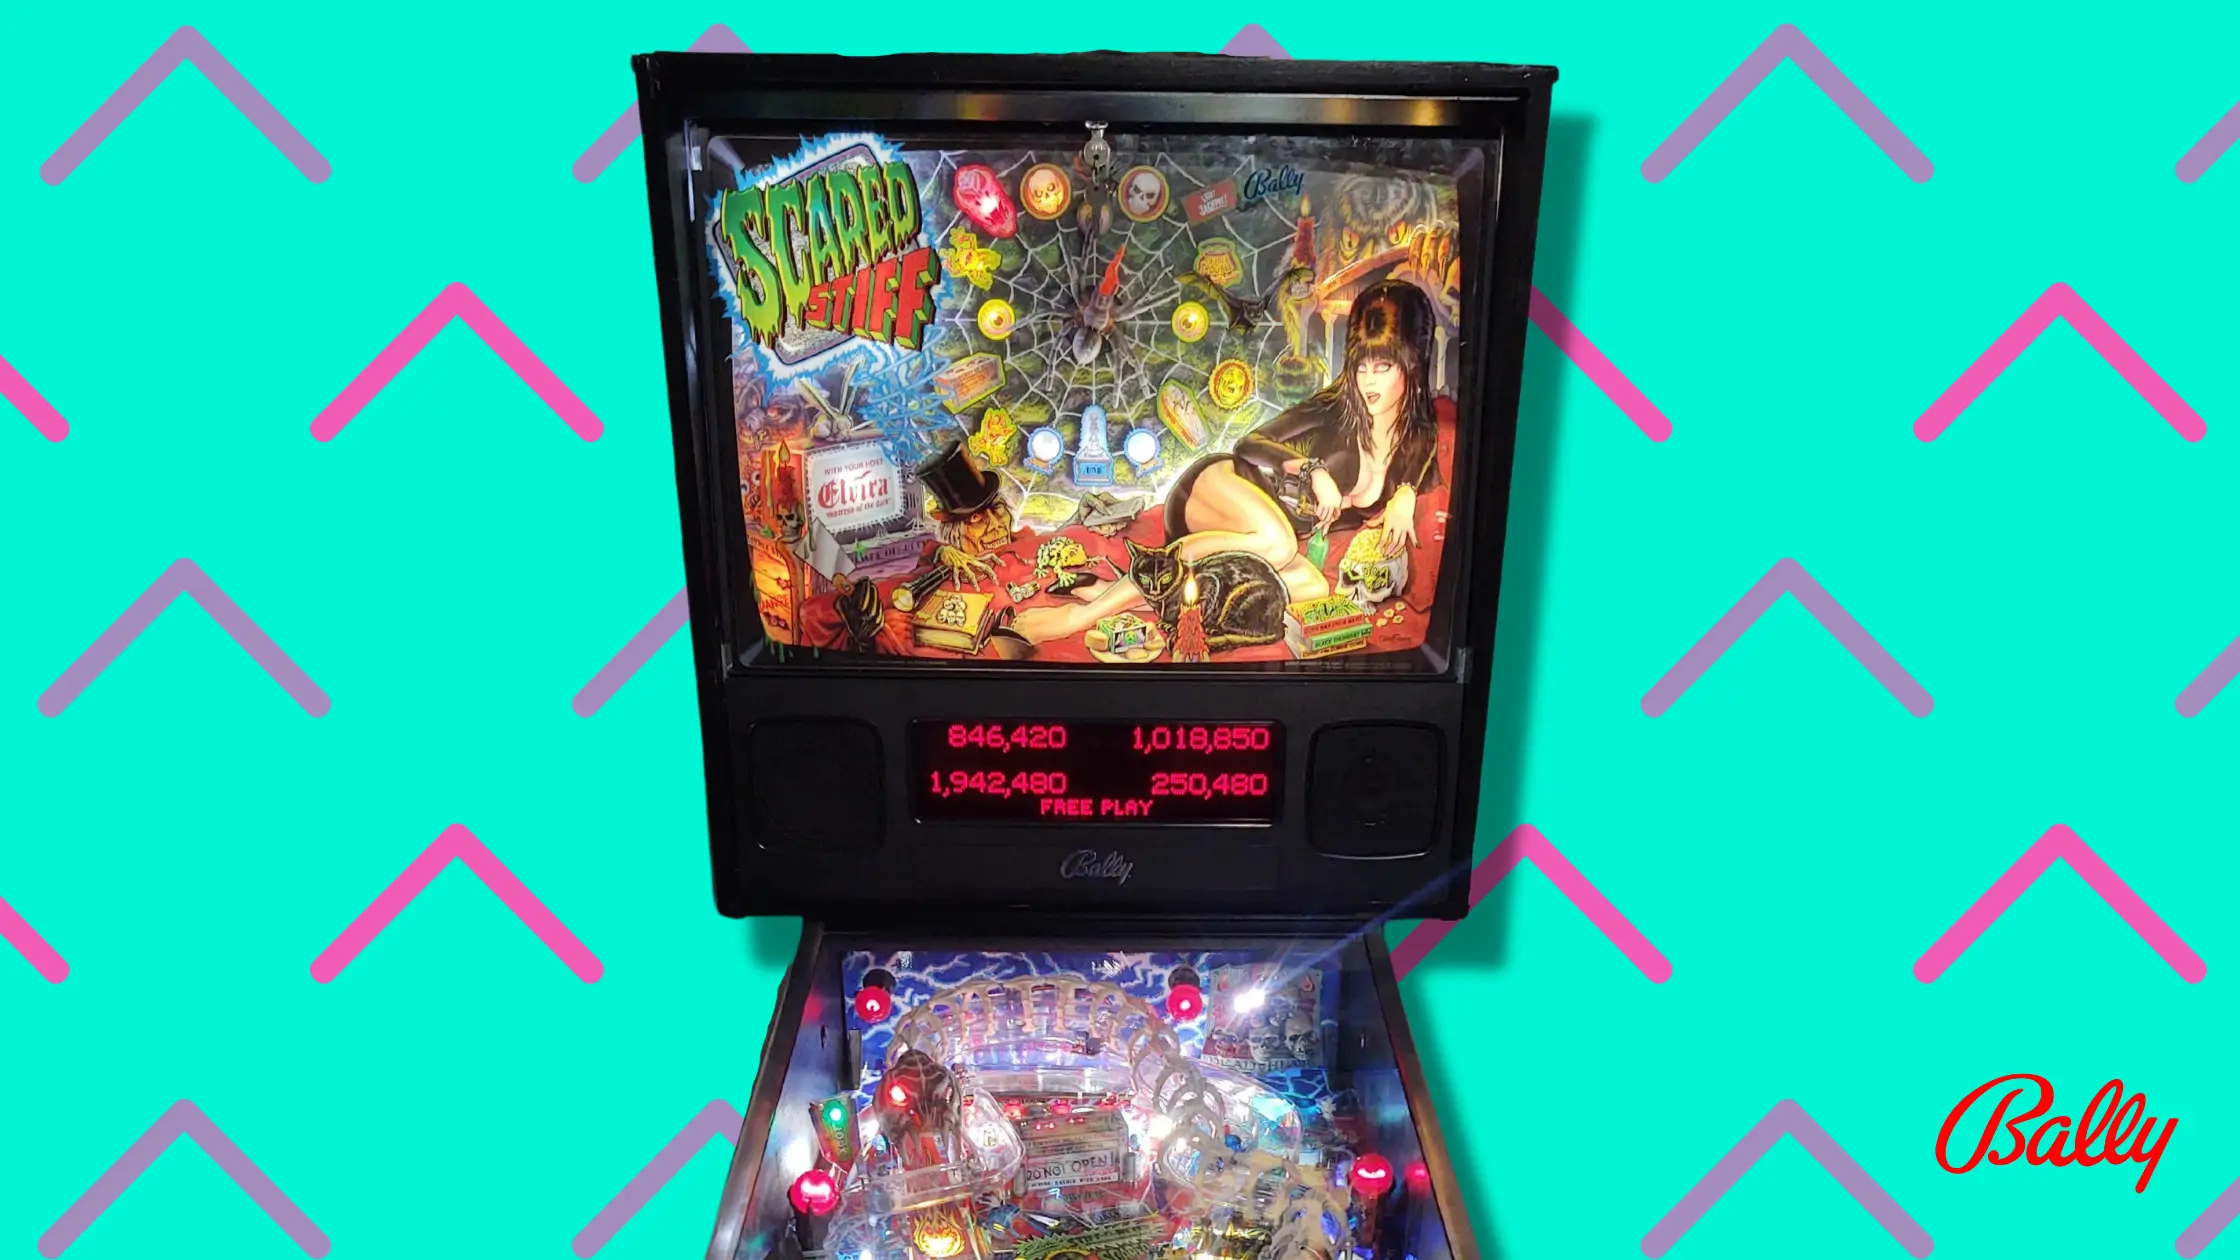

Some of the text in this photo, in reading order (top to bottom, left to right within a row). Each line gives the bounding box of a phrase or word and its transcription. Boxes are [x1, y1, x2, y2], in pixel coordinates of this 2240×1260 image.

[1243, 164, 1305, 200] Bally
[720, 162, 922, 349] SCARED
[805, 246, 941, 351] STIFF
[824, 458, 884, 476] WITH YOUR HOST
[817, 470, 889, 509] Elvira
[864, 500, 874, 510] the
[947, 724, 1067, 754] 846,420
[1133, 725, 1270, 755] 1,018,850
[930, 770, 1068, 799] 1,942,480
[1151, 772, 1269, 800] 250,480
[1040, 798, 1154, 817] FREE PLAY
[1059, 849, 1134, 886] Bally
